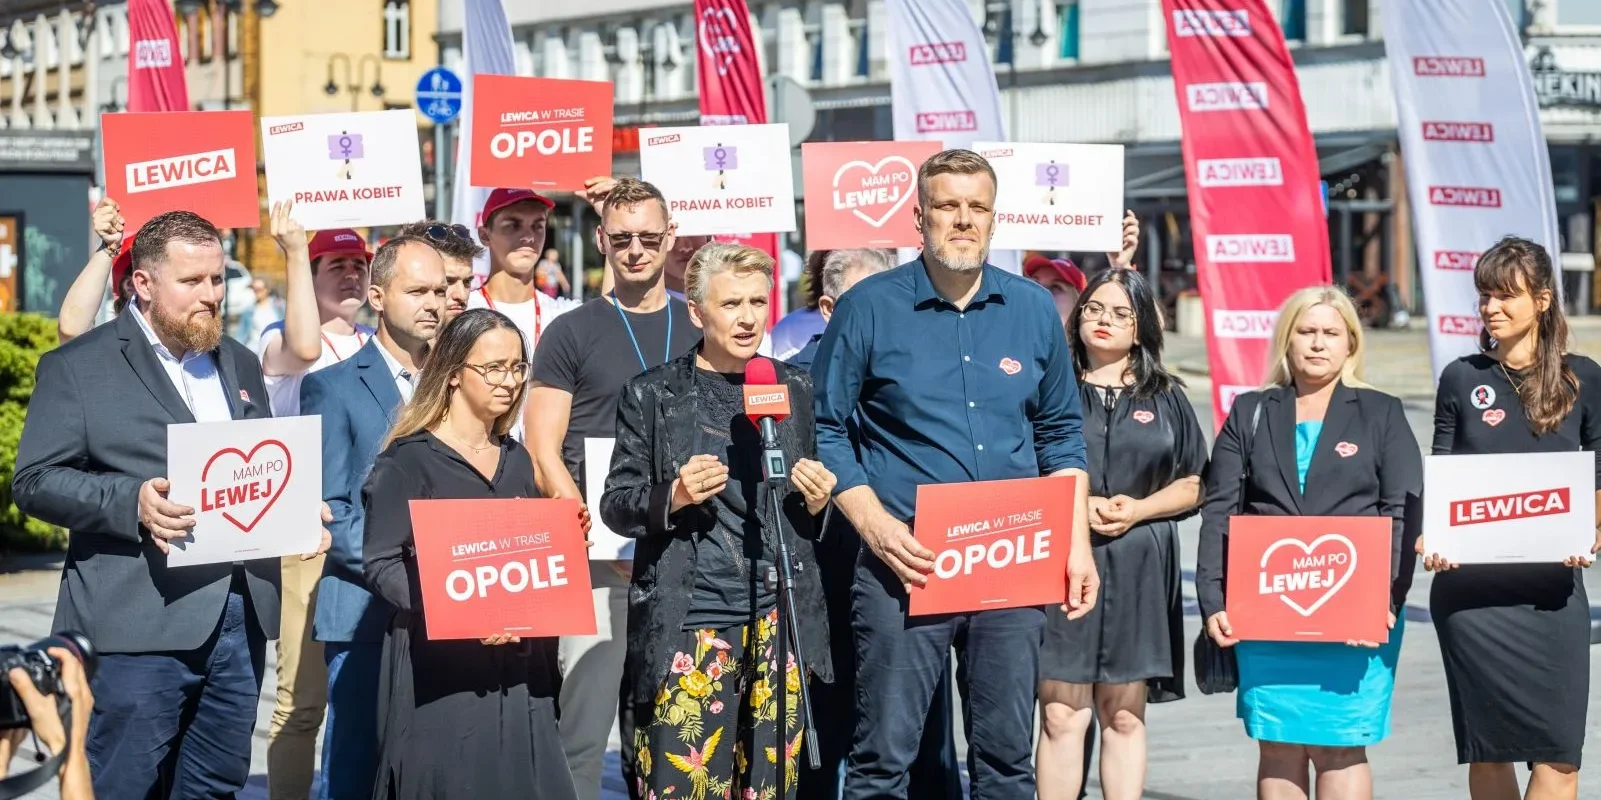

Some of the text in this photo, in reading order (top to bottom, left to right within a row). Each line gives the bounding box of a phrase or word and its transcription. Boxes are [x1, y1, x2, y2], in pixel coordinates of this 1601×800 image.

[501, 107, 585, 123] LEWICA W TRASIE
[271, 123, 303, 135] LEWICA
[649, 134, 680, 146] LEWICA
[490, 126, 594, 159] OPOLE
[133, 154, 230, 187] LEWICA
[861, 171, 909, 188] MAM PO
[295, 186, 403, 204] PRAWA KOBIET
[670, 196, 774, 212] PRAWA KOBIET
[832, 186, 900, 210] LEWEJ
[998, 213, 1104, 226] PRAWA KOBIET
[750, 394, 783, 404] LEWICA
[233, 459, 284, 482] MAM PO
[201, 478, 272, 512] LEWEJ
[1456, 491, 1565, 523] LEWICA
[947, 509, 1043, 537] LEWICA W TRASIE
[452, 532, 550, 556] LEWICA W TRASIE
[934, 529, 1052, 580] OPOLE
[1293, 552, 1348, 570] MAM PO
[445, 554, 569, 602] OPOLE
[1258, 568, 1335, 595] LEWEJ
